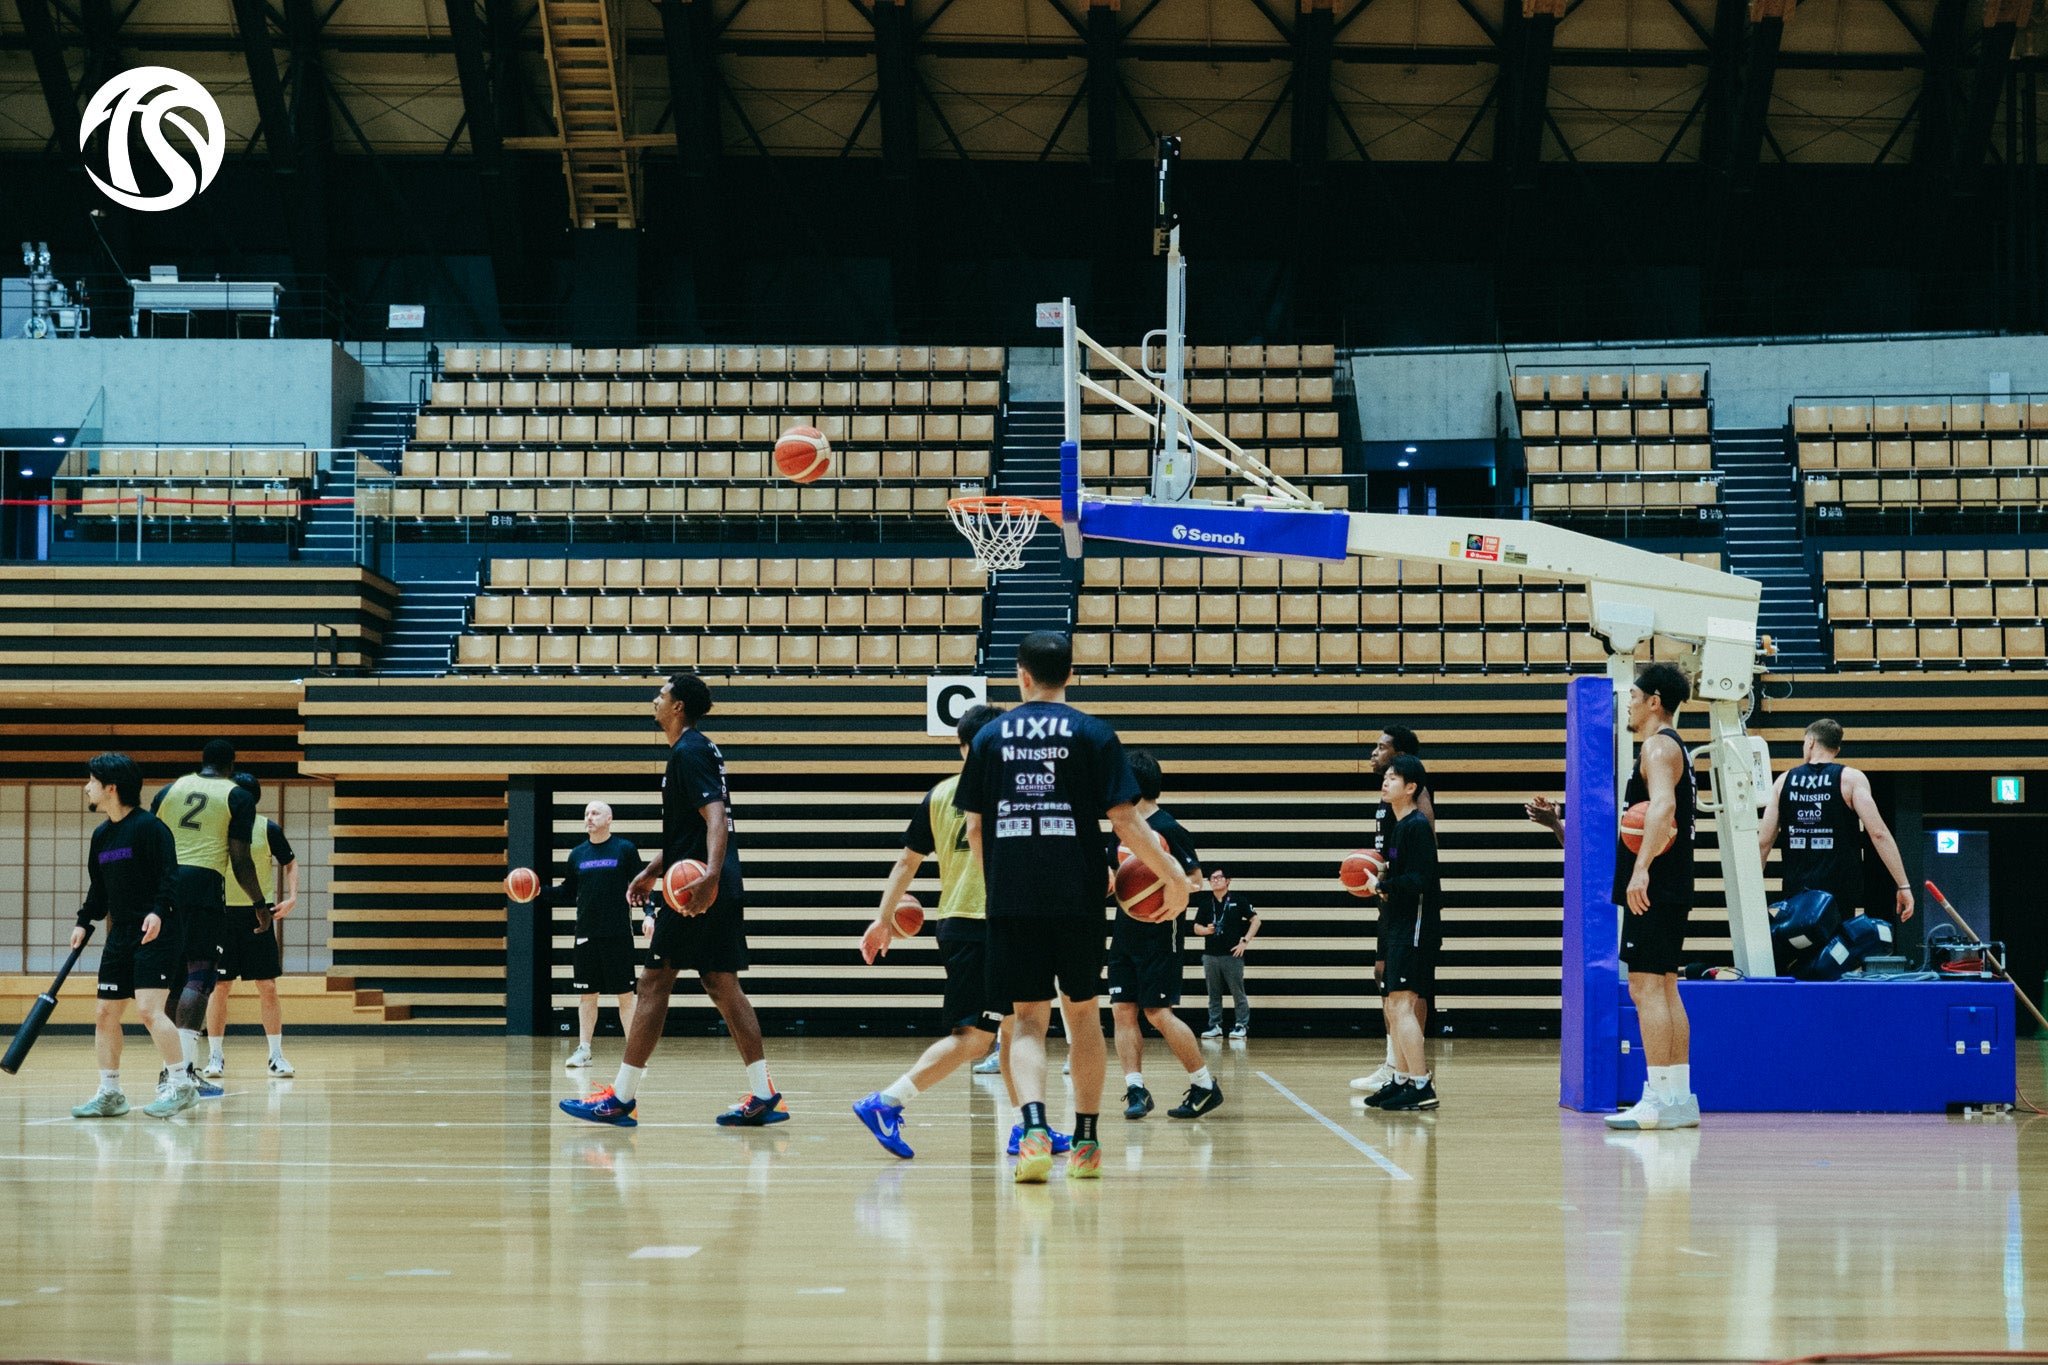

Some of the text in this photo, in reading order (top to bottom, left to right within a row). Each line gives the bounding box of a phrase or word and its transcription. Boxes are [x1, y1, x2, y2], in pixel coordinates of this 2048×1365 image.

[1700, 508, 1708, 520] B
[1819, 506, 1827, 518] B
[491, 515, 499, 526] B
[1188, 528, 1245, 545] Senoh
[936, 684, 976, 728] C
[1001, 716, 1073, 740] LIXIL
[1016, 747, 1069, 761] NISSHO
[1015, 773, 1055, 785] GYRO
[1791, 774, 1832, 790] LIXIL
[1798, 793, 1831, 802] NISSHO
[178, 790, 210, 832] 2
[1797, 809, 1822, 818] GYRO
